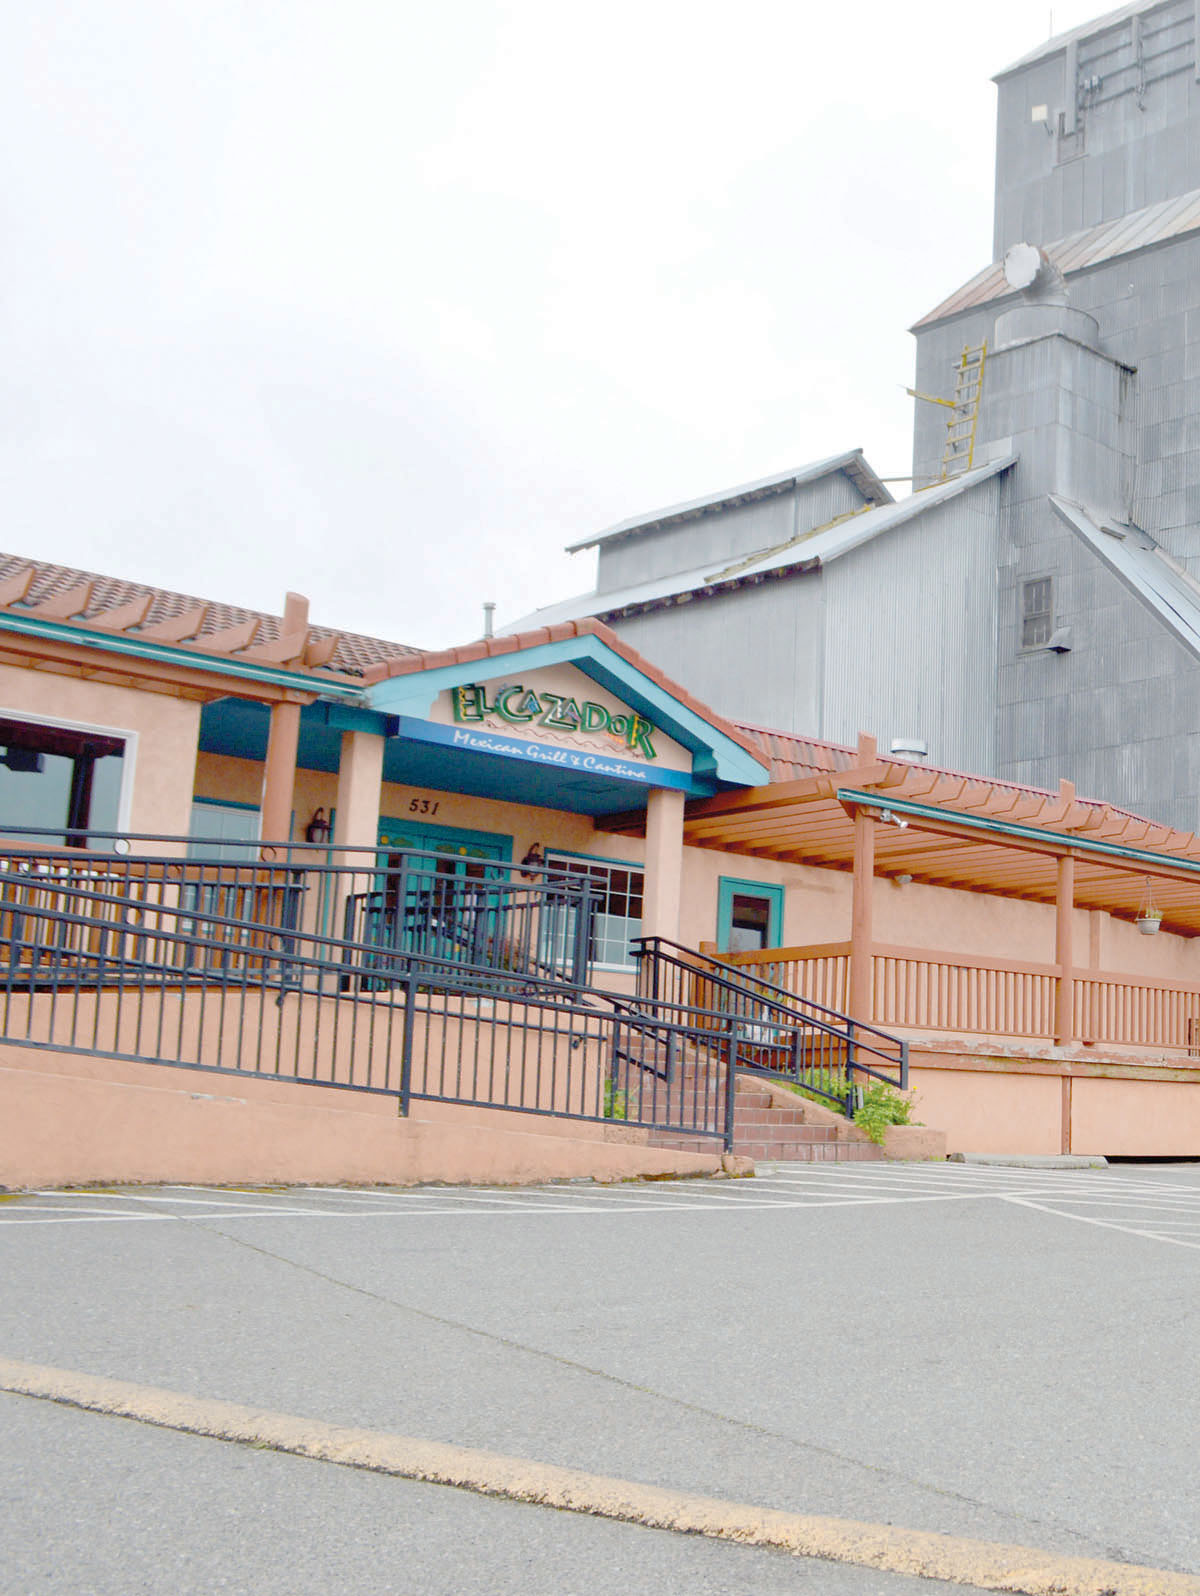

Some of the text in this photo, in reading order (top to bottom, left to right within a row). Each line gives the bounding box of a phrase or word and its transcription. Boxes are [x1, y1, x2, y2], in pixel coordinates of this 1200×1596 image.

[453, 683, 657, 758] EL CAZADOR
[453, 730, 647, 778] Mexican Grill & Cantina
[409, 798, 440, 815] 531
